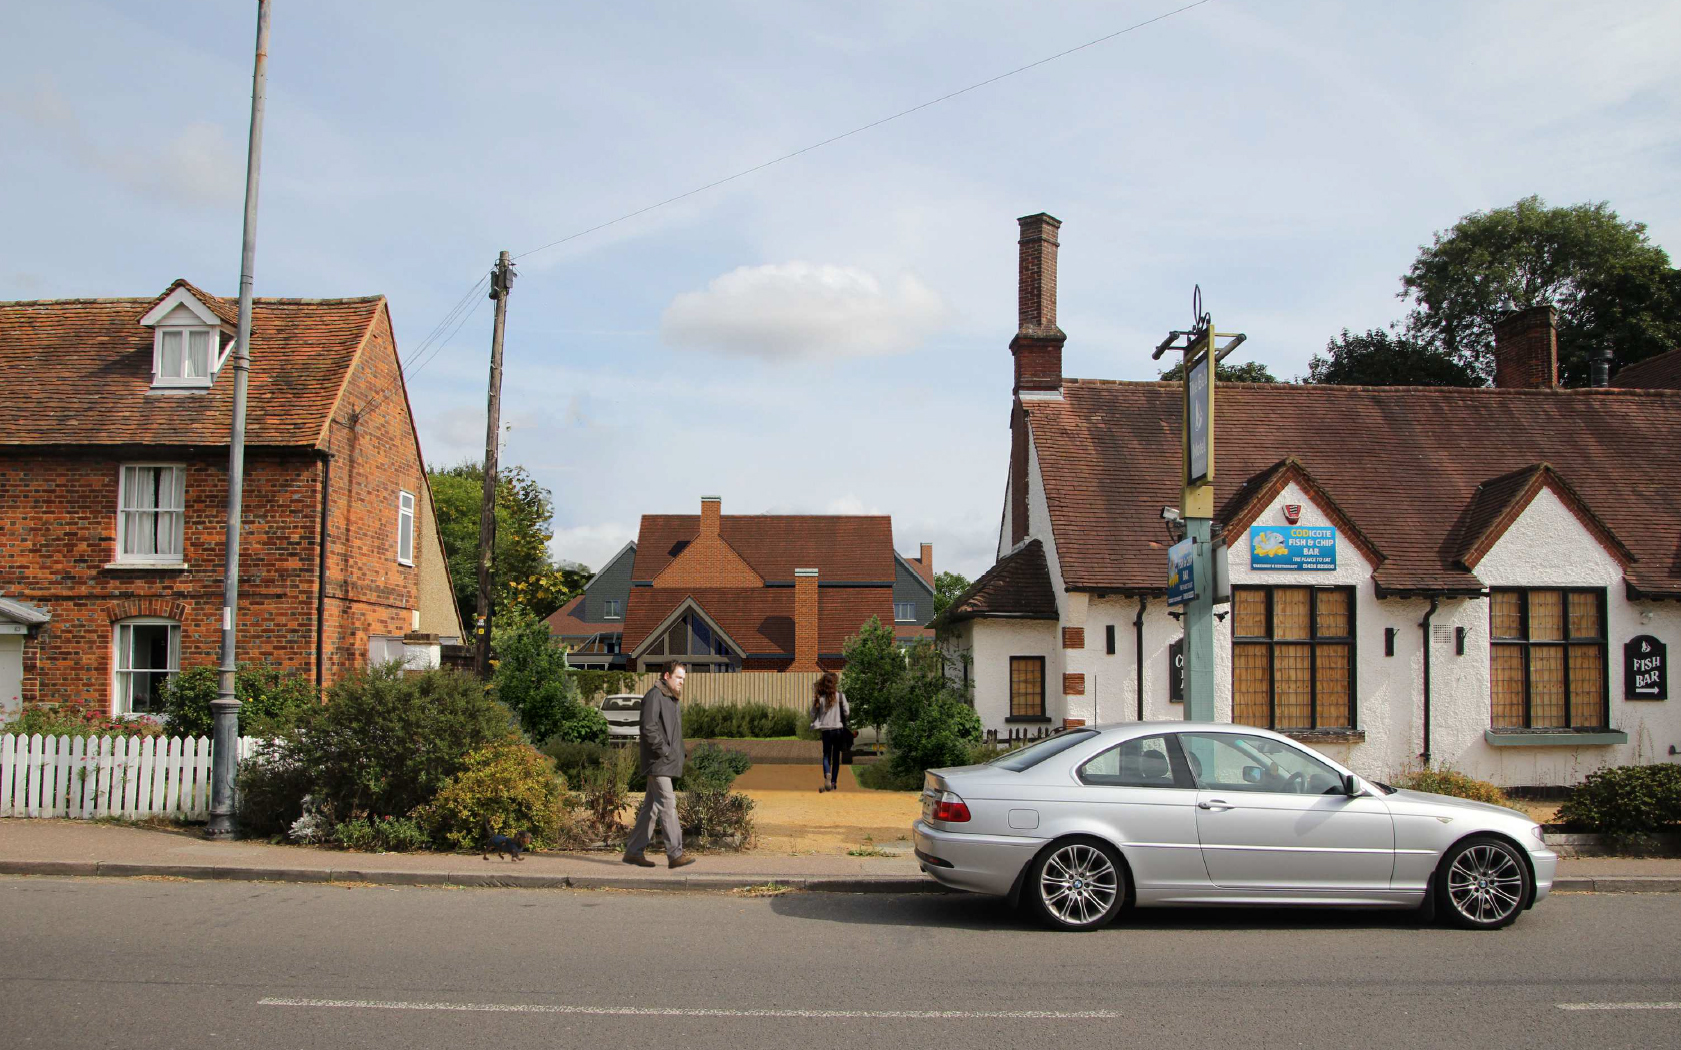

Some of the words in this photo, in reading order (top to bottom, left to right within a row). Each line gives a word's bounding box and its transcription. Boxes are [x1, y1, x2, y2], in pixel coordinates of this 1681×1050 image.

[1291, 529, 1331, 537] CODICOTE
[1315, 539, 1334, 547] CHIP
[1633, 657, 1660, 671] FISH
[1636, 671, 1660, 687] BAR
